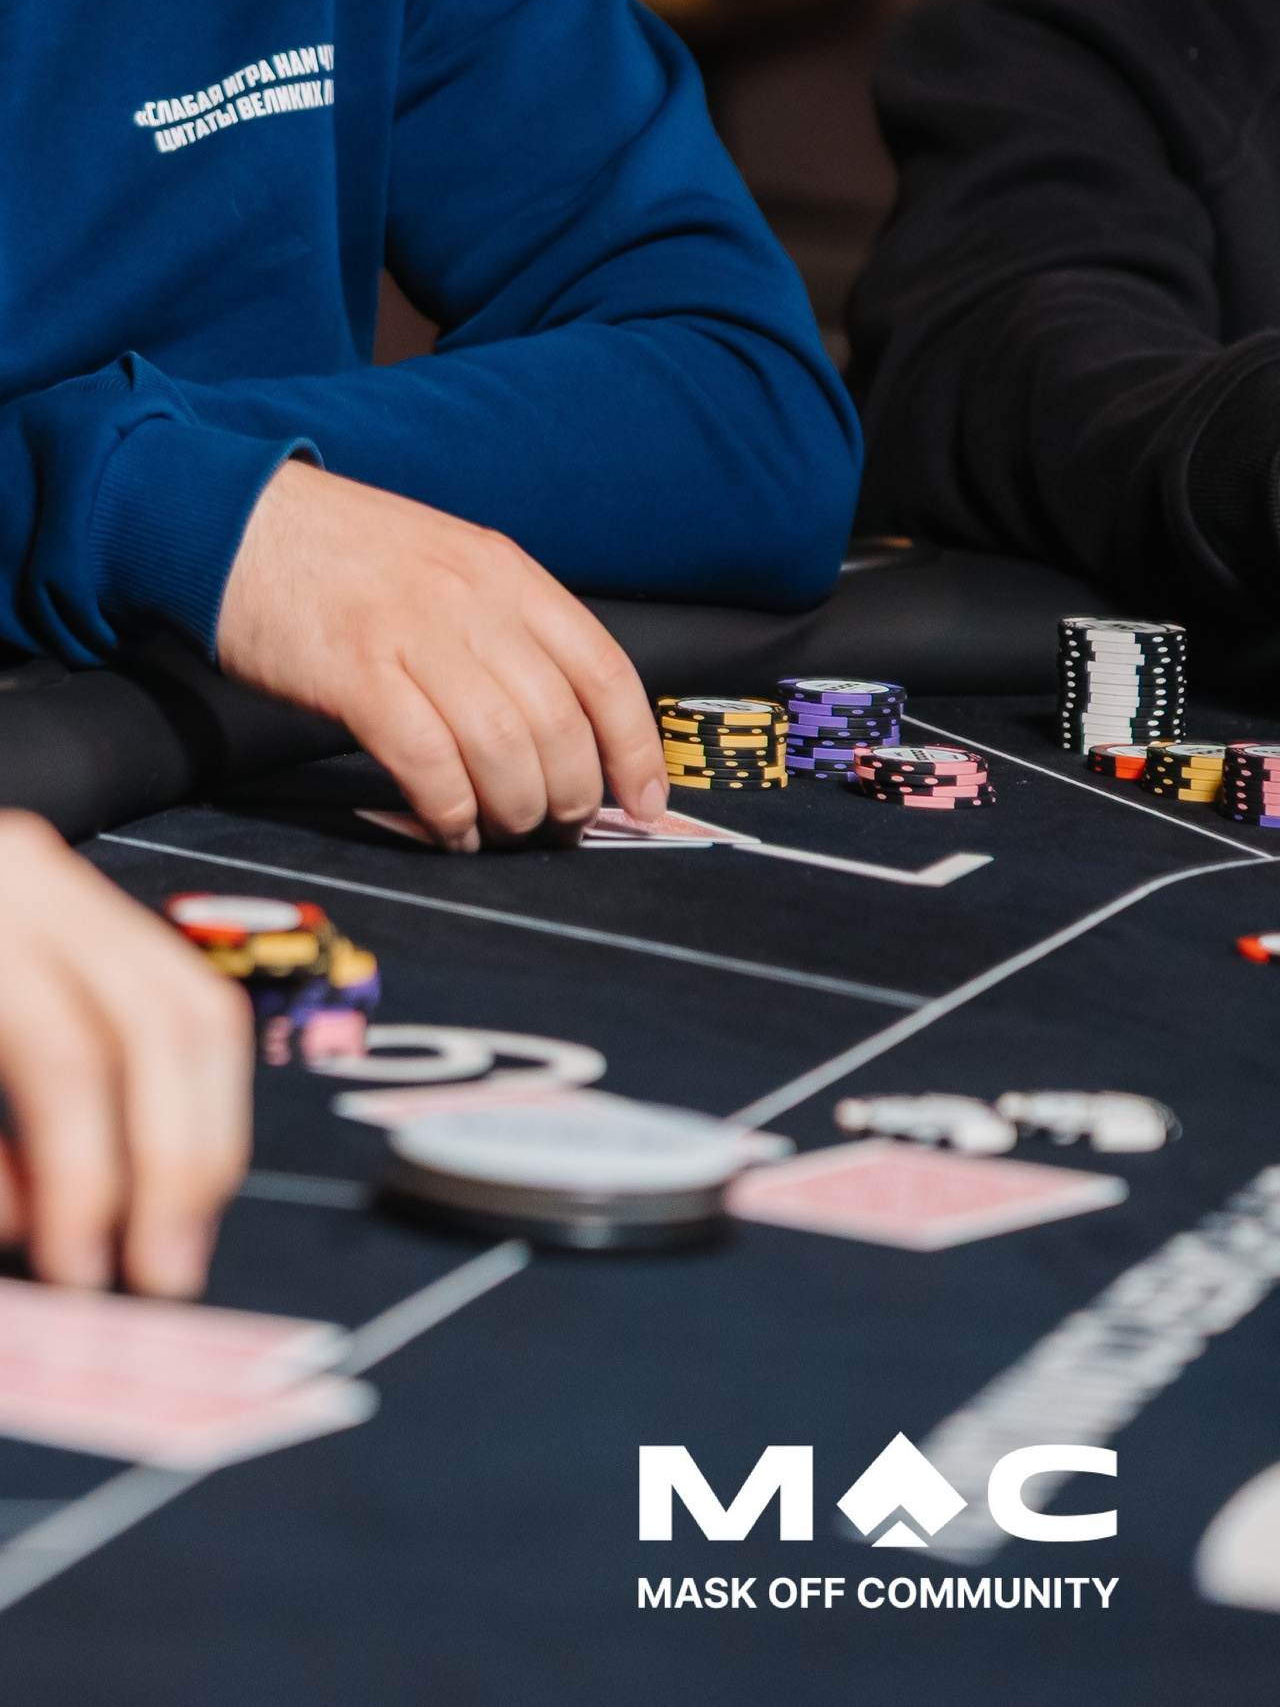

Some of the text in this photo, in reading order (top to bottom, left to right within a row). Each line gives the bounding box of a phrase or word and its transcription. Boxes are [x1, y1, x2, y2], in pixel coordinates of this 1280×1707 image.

[222, 59, 276, 98] ИГРА
[272, 46, 319, 79] НАМ
[154, 103, 238, 154] ЦИТАТЫ
[235, 80, 323, 121] ВЕЛИКИХ
